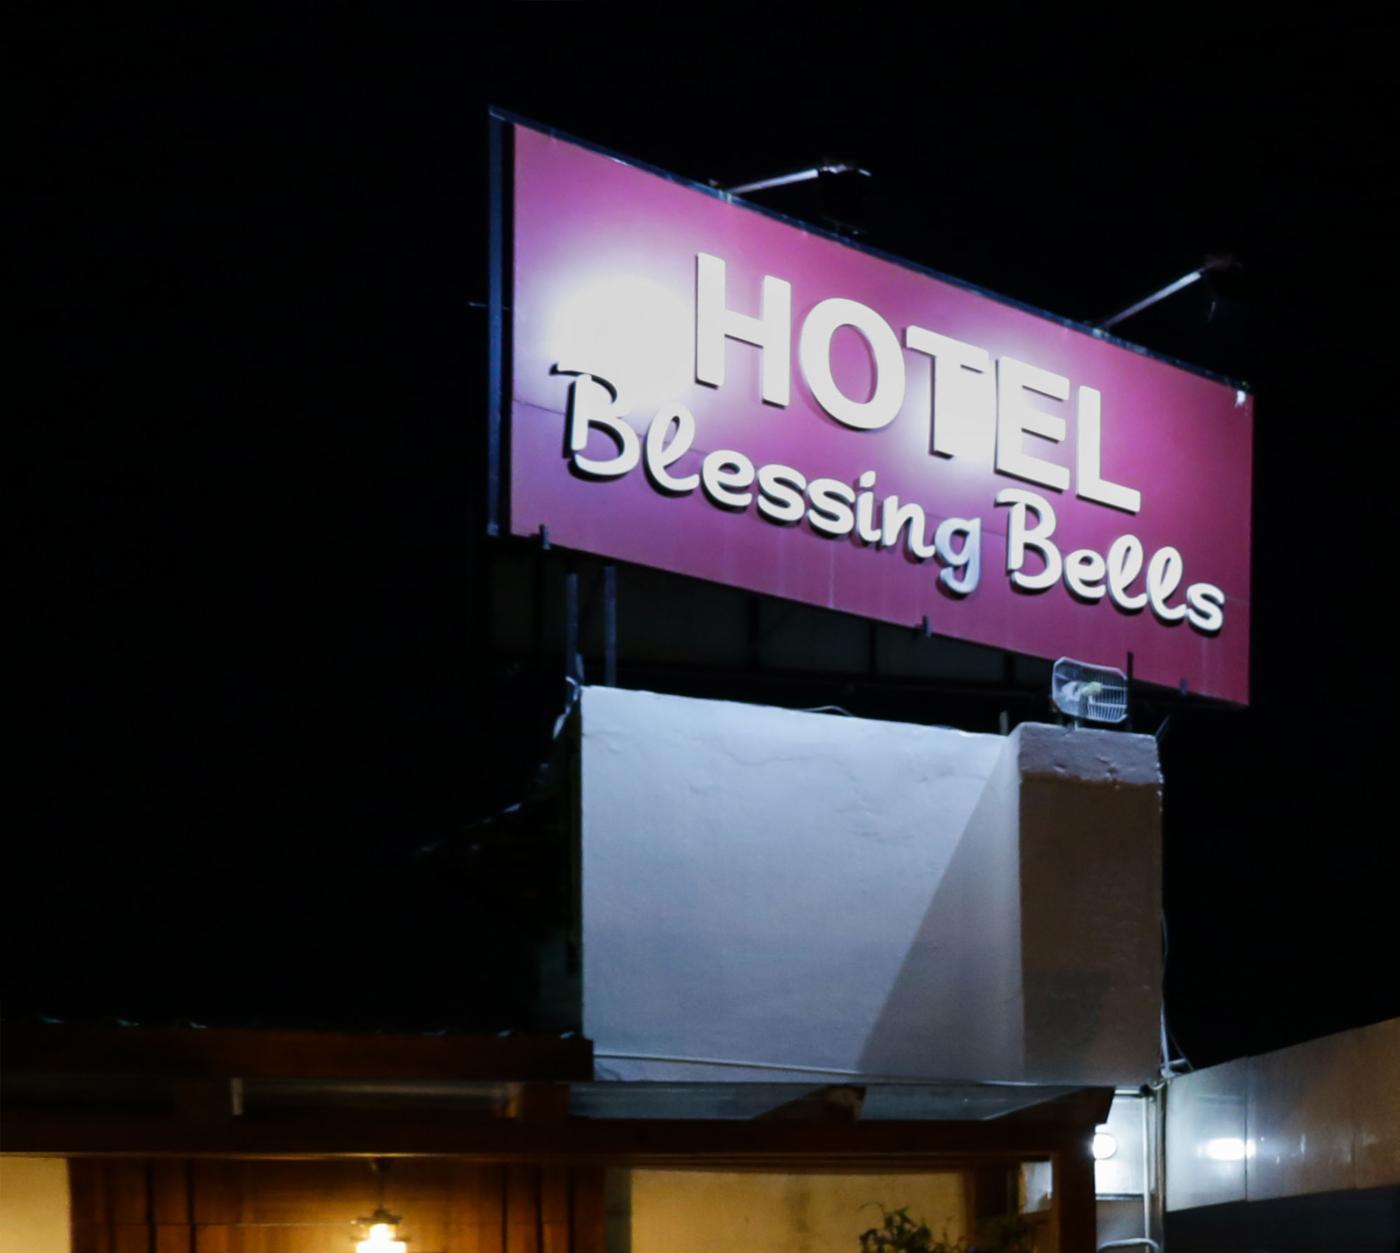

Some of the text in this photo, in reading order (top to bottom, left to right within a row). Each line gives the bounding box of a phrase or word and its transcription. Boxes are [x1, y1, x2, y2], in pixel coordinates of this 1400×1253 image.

[549, 361, 1227, 633] Blessing Bells
[695, 252, 1142, 513] HOTEL
